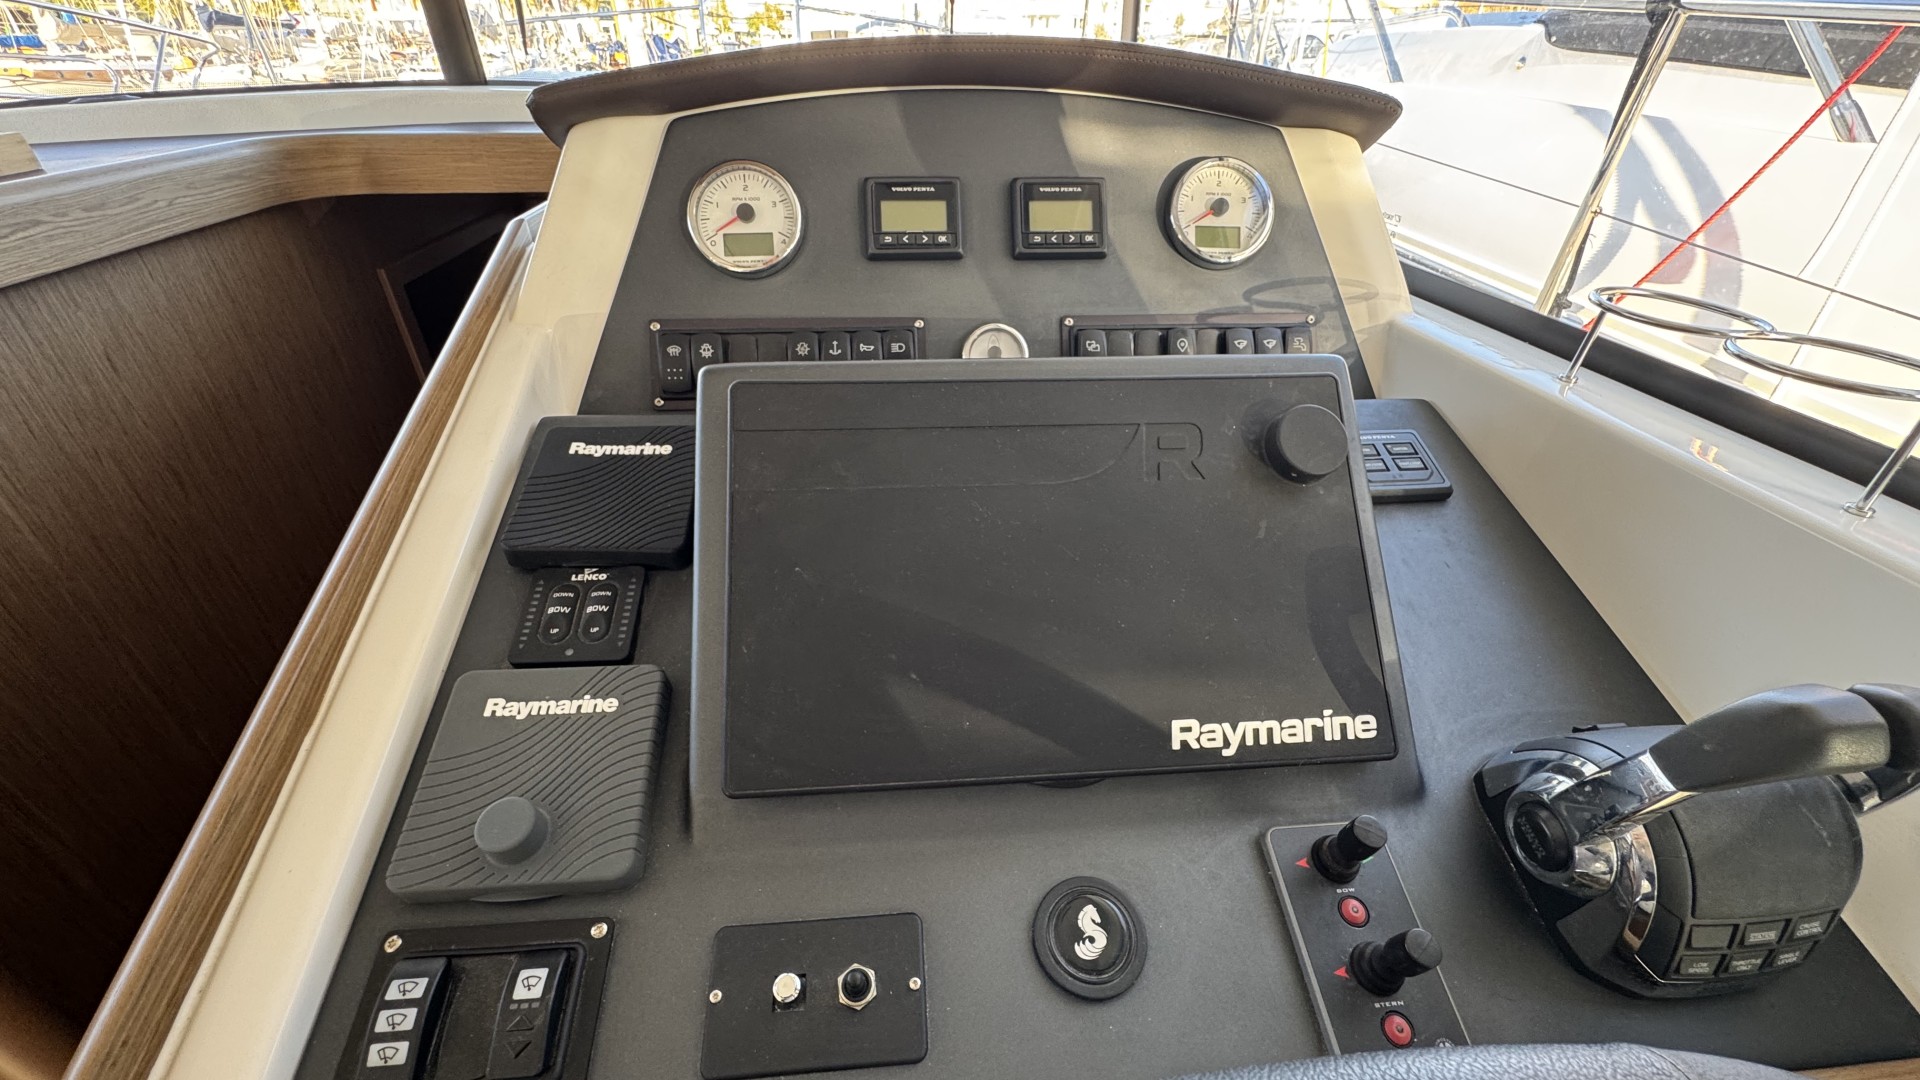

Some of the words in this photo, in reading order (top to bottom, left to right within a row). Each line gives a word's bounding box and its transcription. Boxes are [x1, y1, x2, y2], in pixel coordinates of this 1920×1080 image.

[1084, 234, 1094, 242] OK
[568, 441, 673, 457] Raymarine
[571, 571, 608, 582] LENCO
[548, 606, 571, 614] BOW
[586, 604, 610, 613] BOW
[483, 694, 619, 720] Raymarine
[1171, 709, 1378, 757] Raymarine
[1374, 1000, 1405, 1008] STERN
